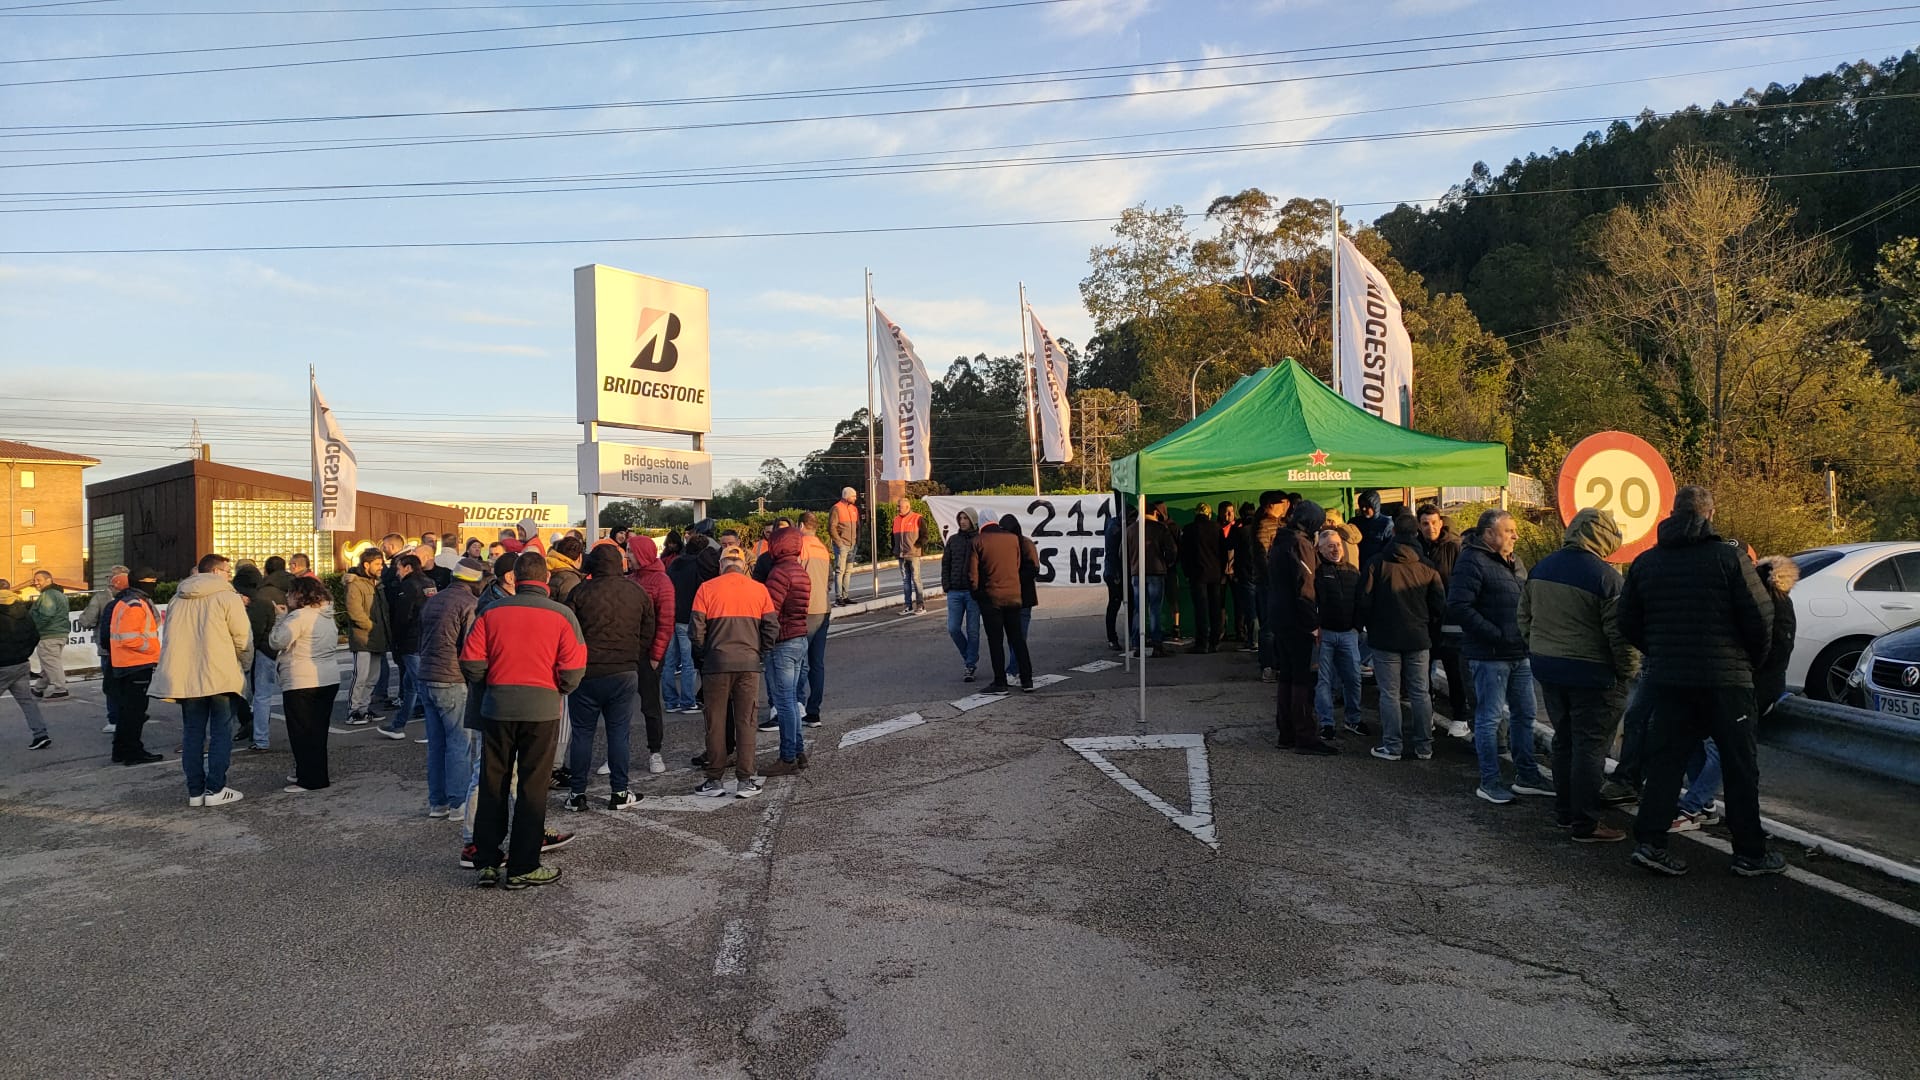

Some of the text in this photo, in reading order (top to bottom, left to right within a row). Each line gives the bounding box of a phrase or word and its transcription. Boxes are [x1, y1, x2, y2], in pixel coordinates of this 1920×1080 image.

[603, 375, 705, 405] BRIDGESTONE
[623, 453, 689, 471] Bridgestone
[621, 469, 693, 486] Hispania S.A.
[1287, 468, 1351, 481] Heineken
[1586, 476, 1651, 519] 20
[454, 504, 551, 521] RIDGESTONE
[1880, 697, 1909, 714] 7955
